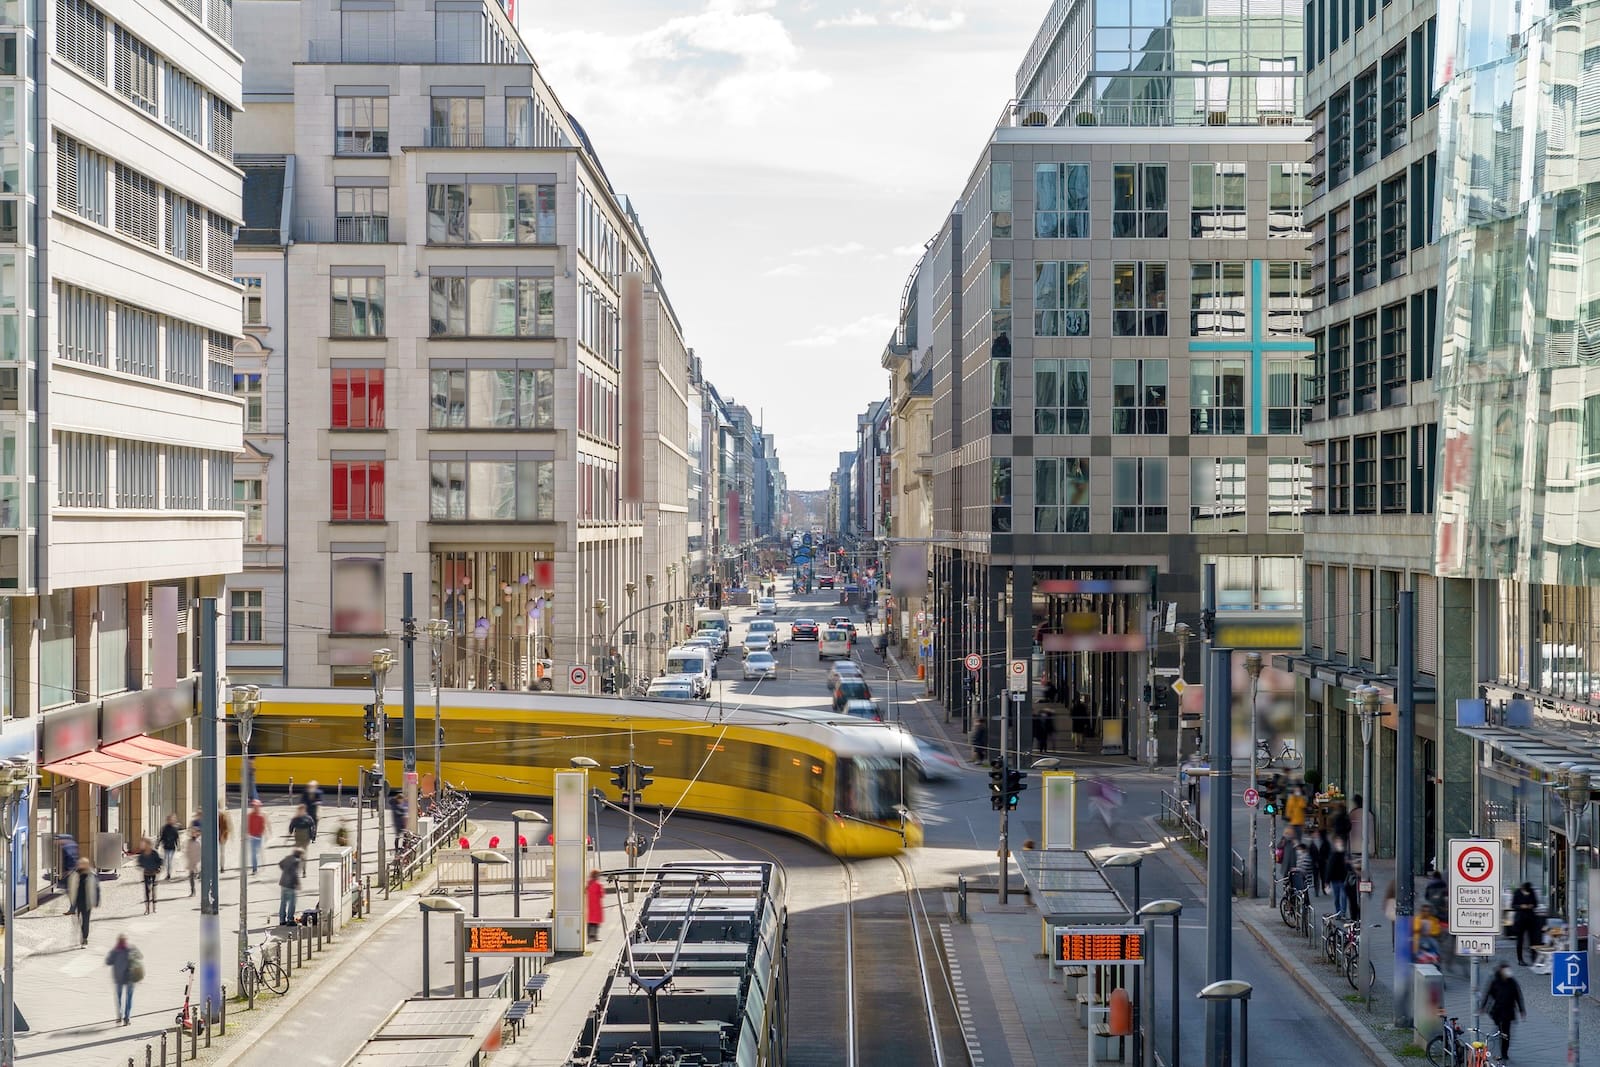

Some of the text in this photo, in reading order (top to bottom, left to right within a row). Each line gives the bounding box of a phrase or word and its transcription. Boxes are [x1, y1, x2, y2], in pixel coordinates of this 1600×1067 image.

[969, 658, 979, 667] 30
[1460, 940, 1491, 950] 100 m
[1568, 963, 1580, 985] P
